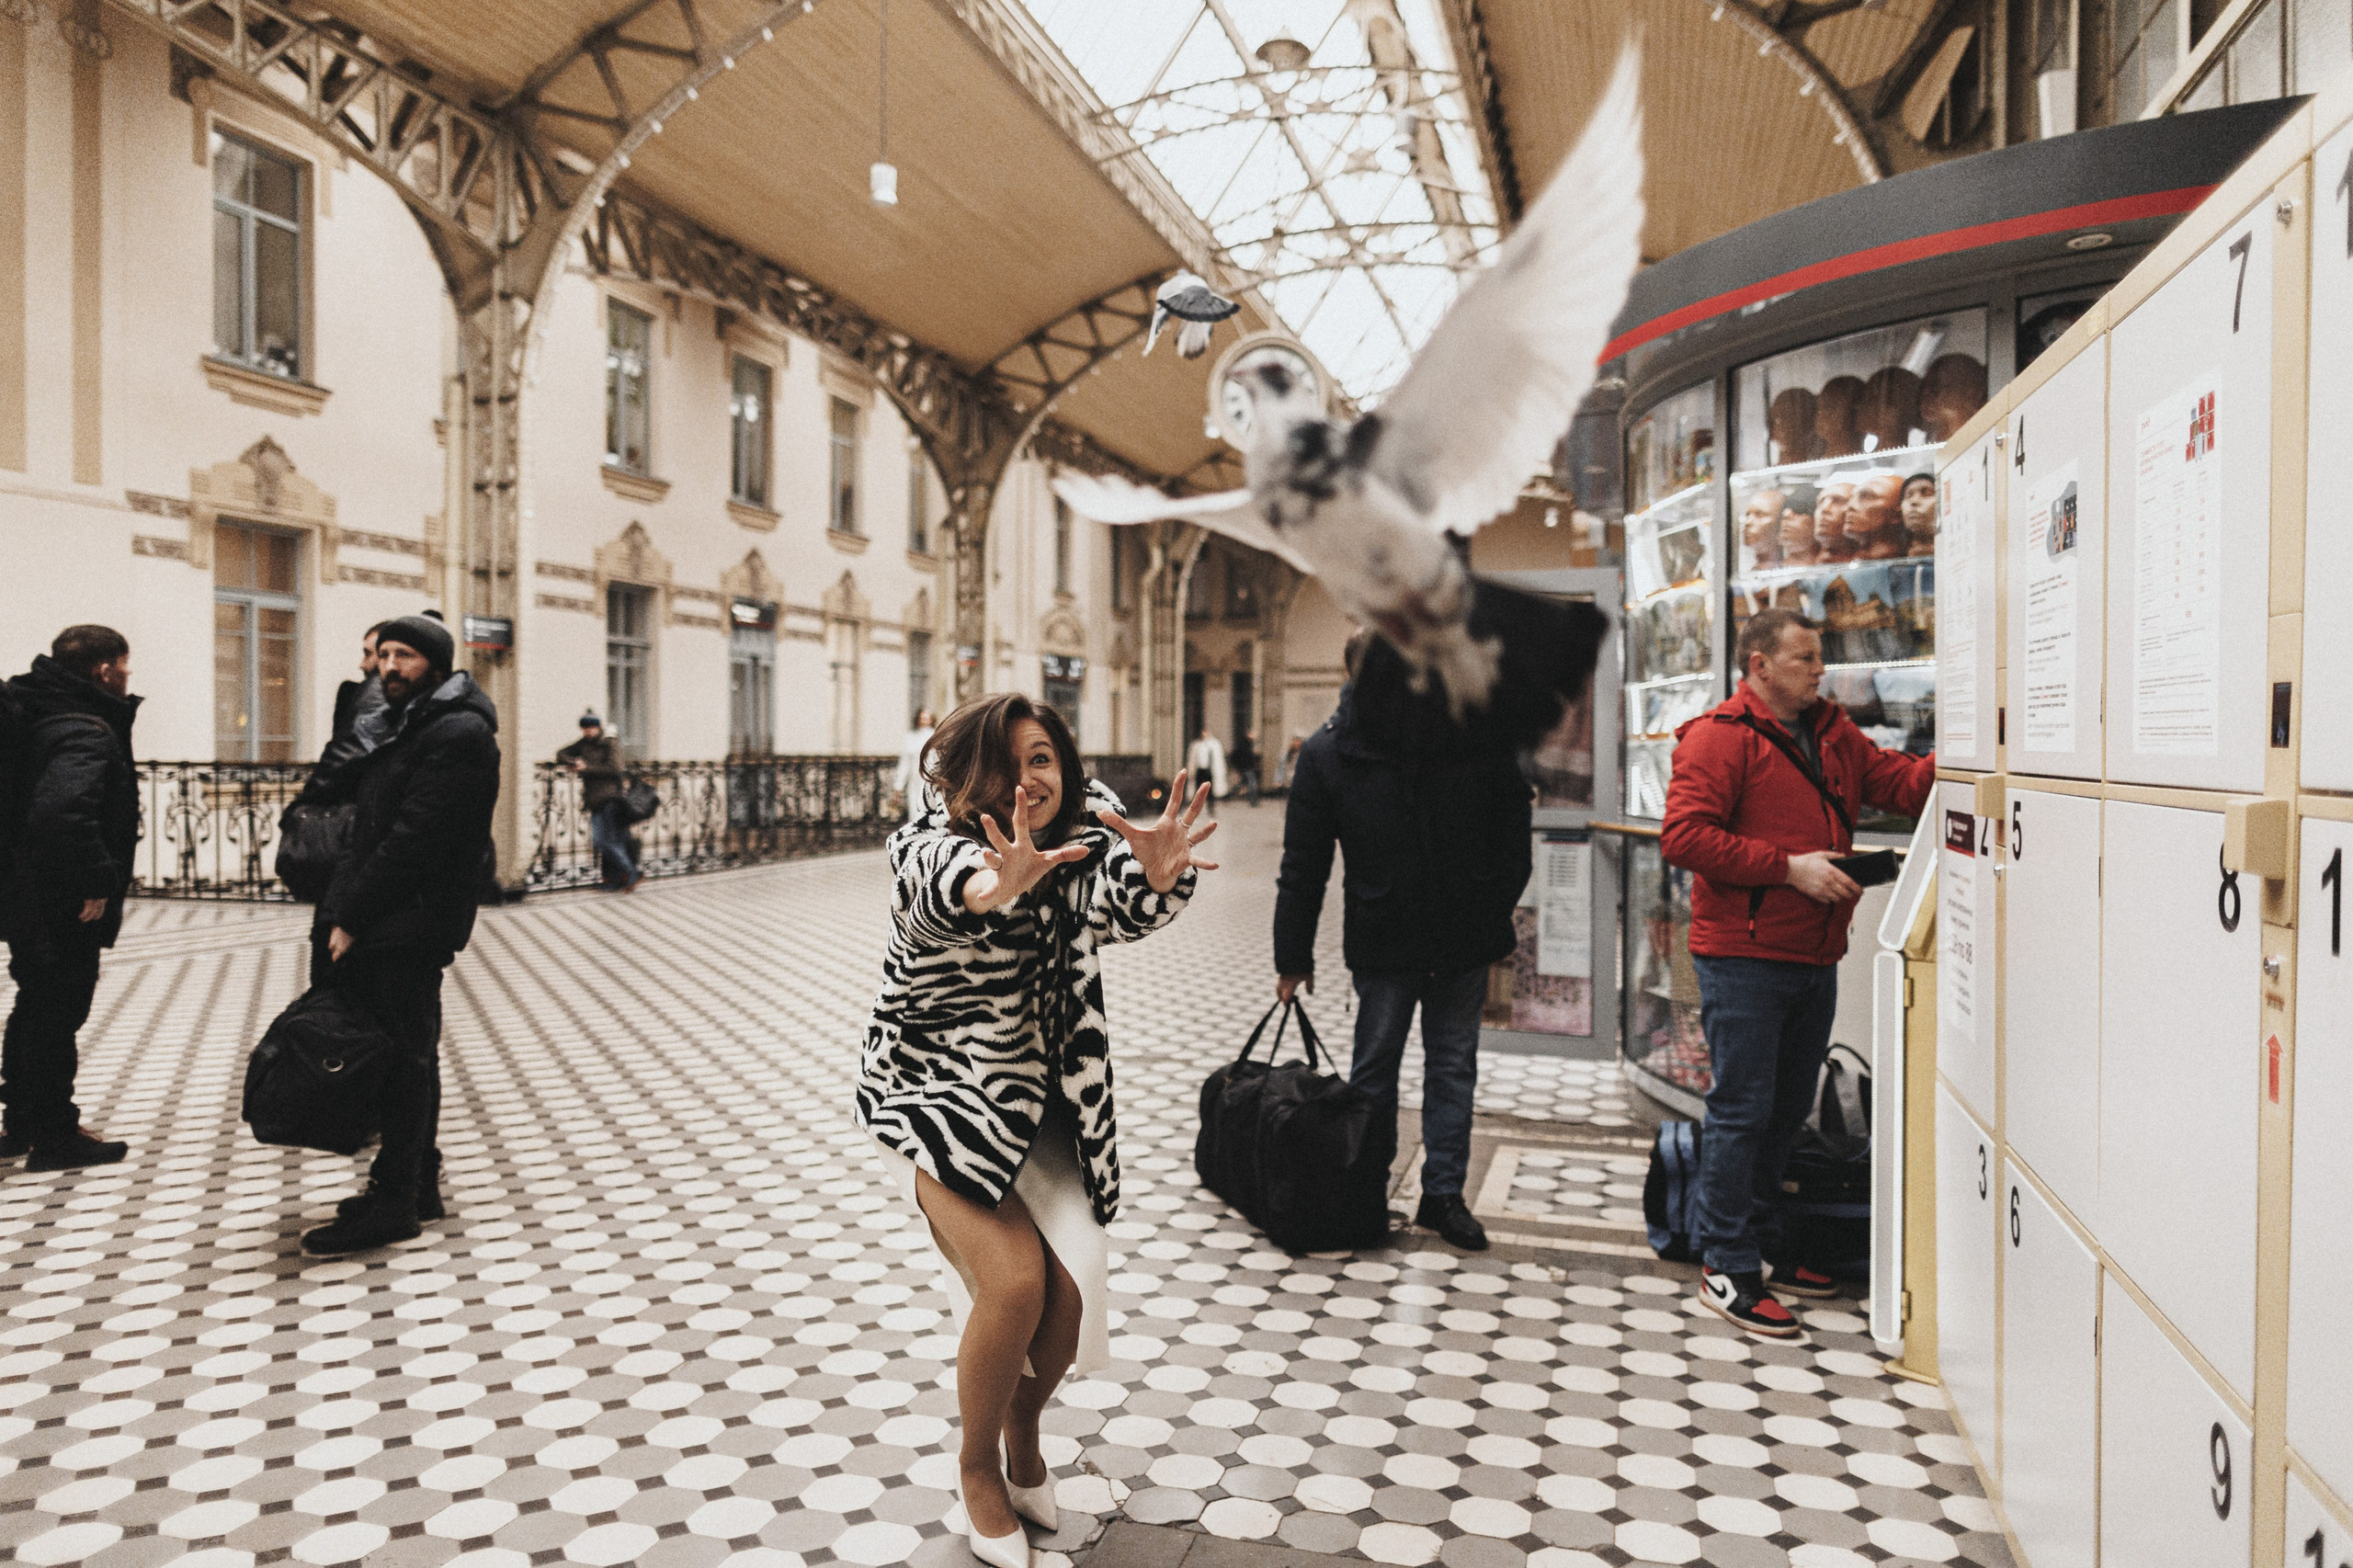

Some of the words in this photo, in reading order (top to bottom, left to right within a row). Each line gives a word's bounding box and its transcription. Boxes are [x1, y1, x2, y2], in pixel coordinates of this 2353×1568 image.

[2229, 231, 2252, 335] 7
[1983, 445, 1988, 502] 1
[2015, 415, 2026, 476] 4
[1981, 816, 1989, 857] 2
[2012, 801, 2022, 861] 5
[2218, 842, 2242, 933] 8
[2322, 847, 2342, 957] 1
[1978, 1143, 1987, 1200] 3
[2010, 1186, 2020, 1248] 6
[2210, 1422, 2233, 1521] 9
